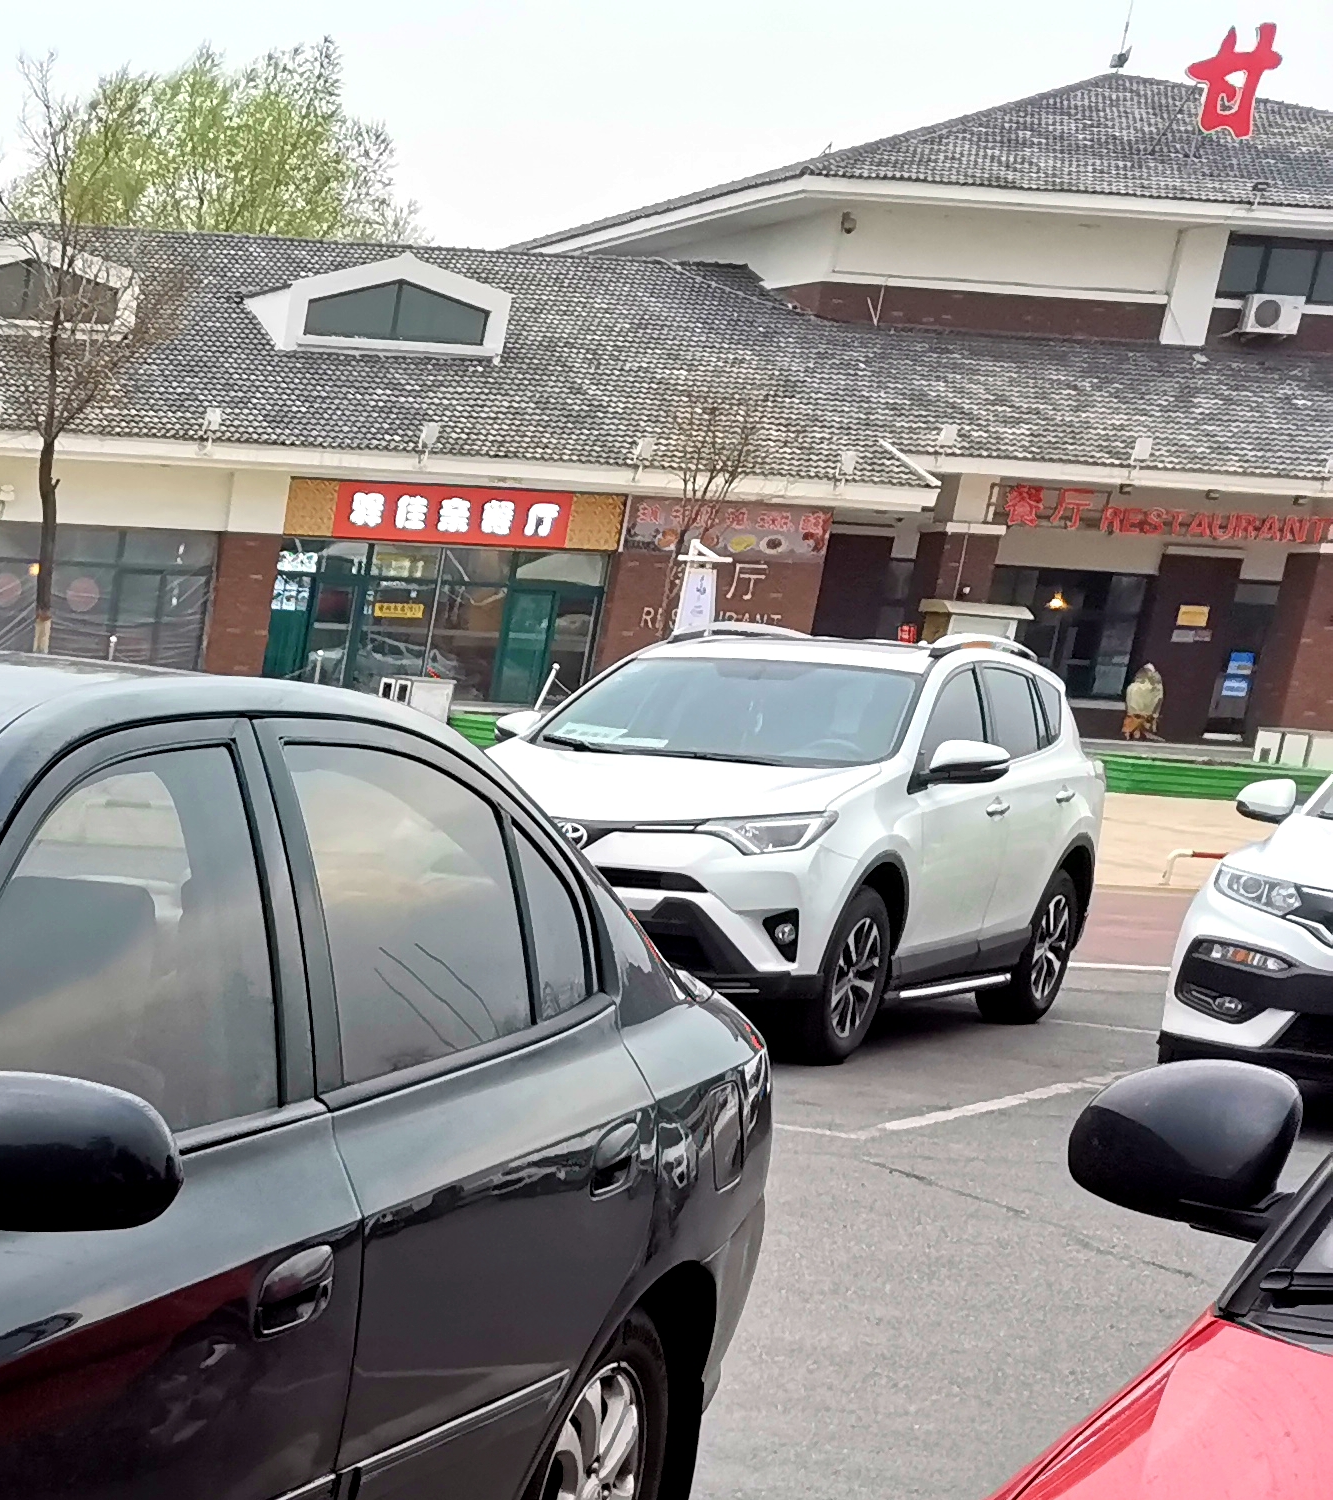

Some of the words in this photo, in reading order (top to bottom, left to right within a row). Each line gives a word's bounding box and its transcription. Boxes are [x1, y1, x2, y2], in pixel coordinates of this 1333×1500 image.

[1185, 22, 1282, 138] 甘
[1004, 484, 1095, 529] 餐厅
[1099, 506, 1332, 543] RESTAURANT
